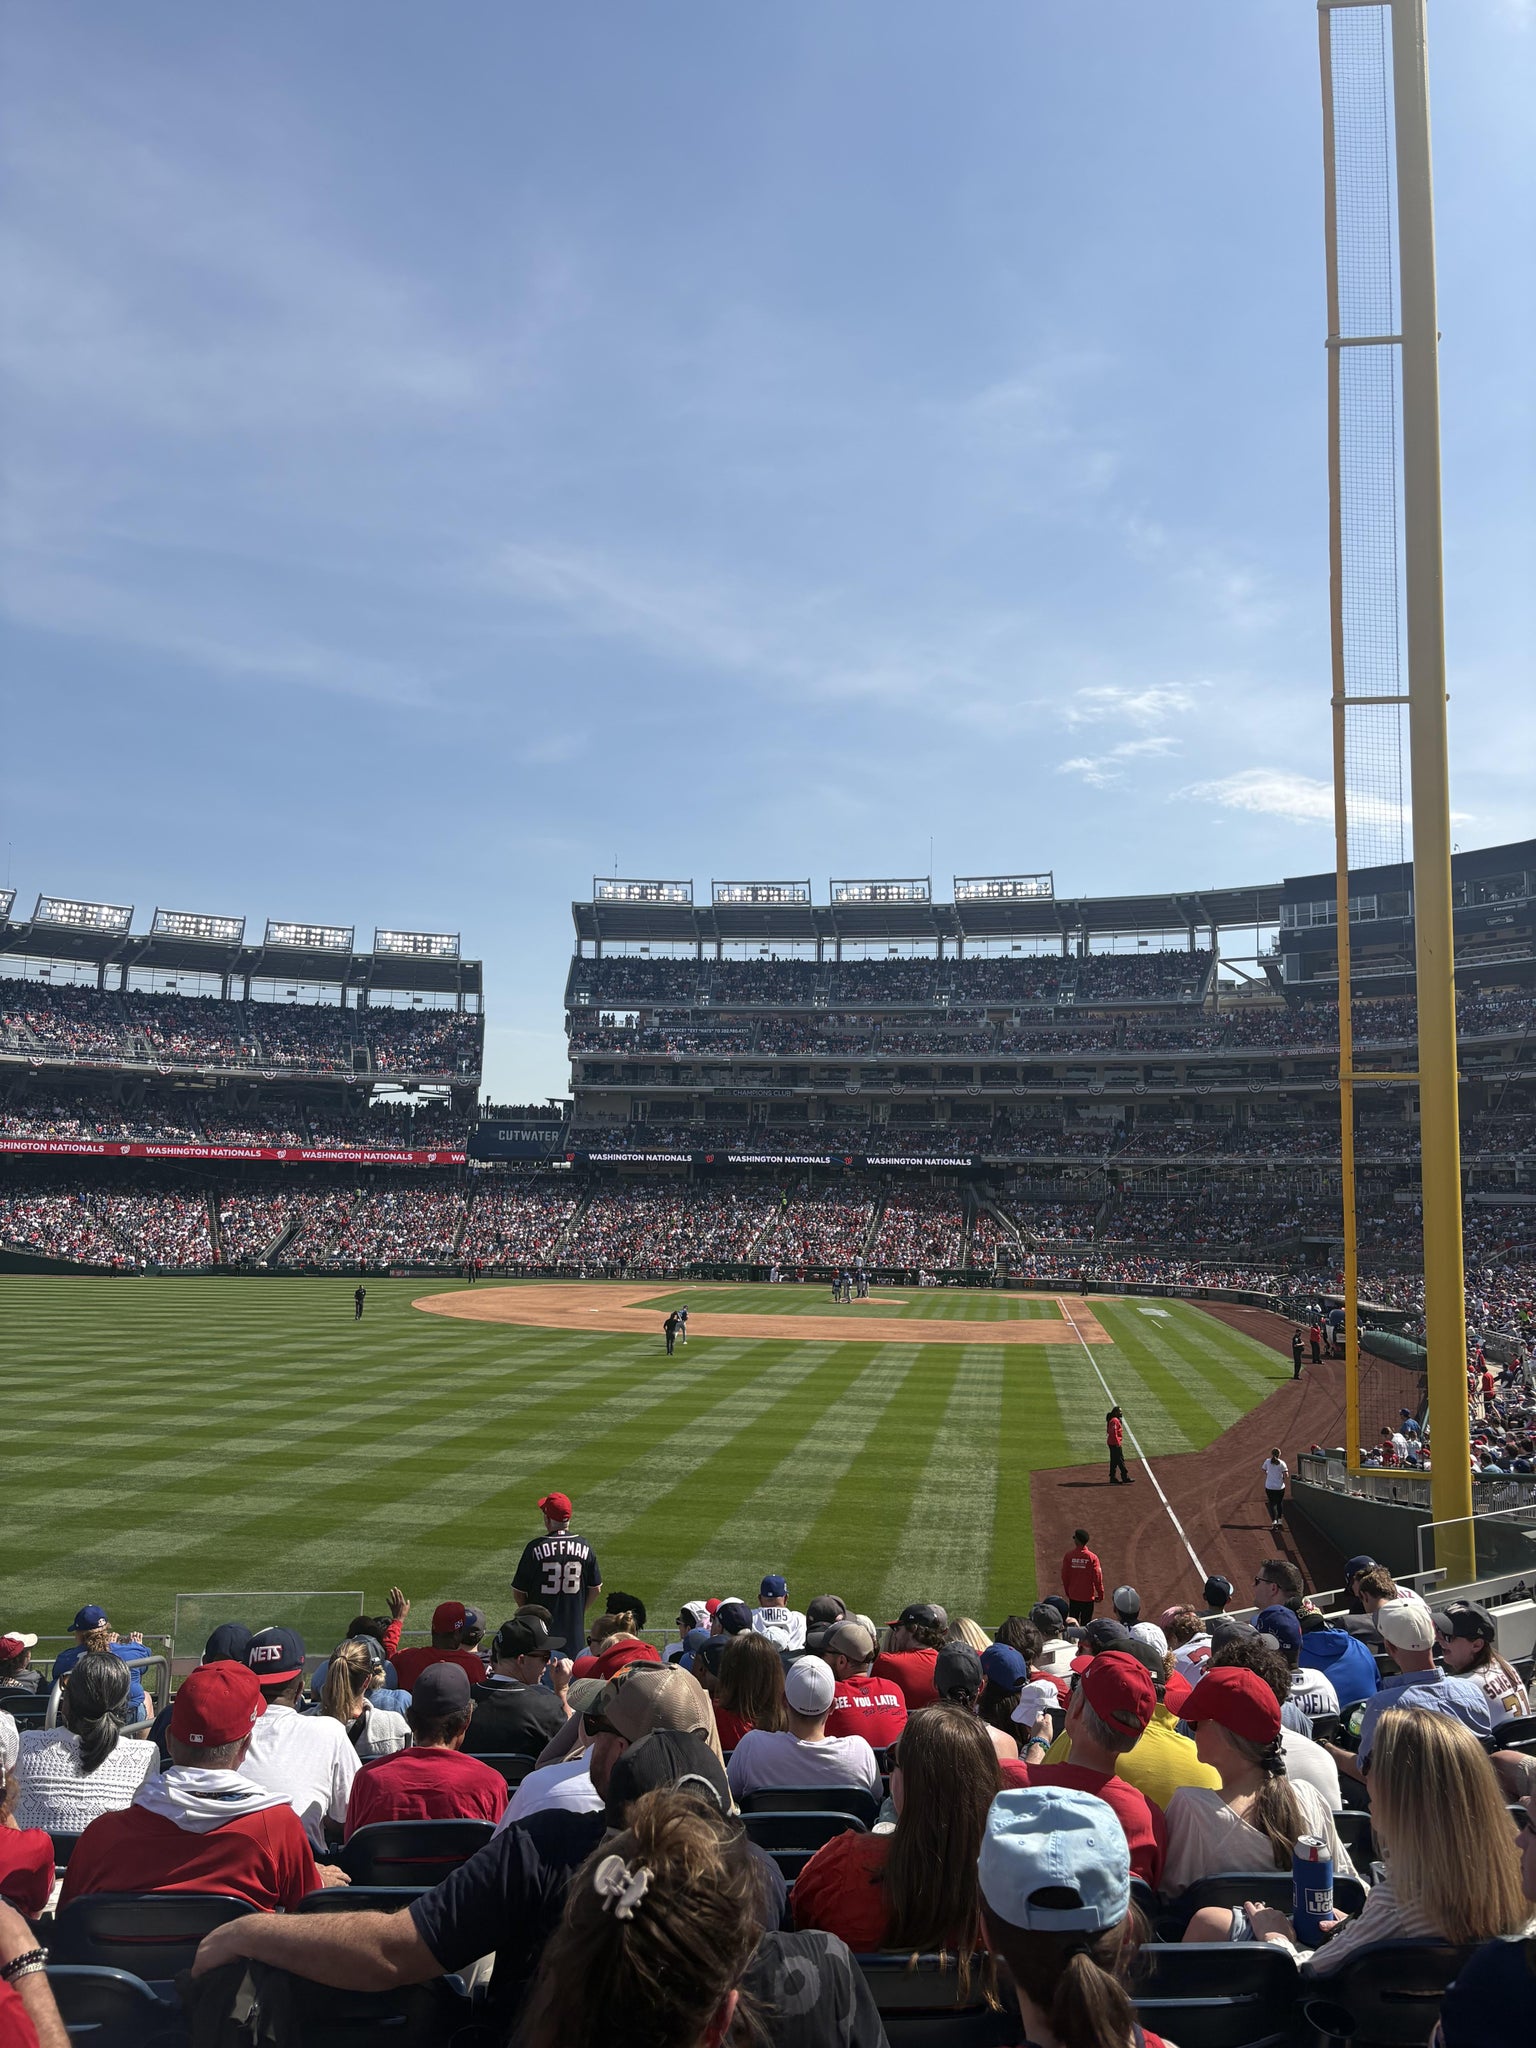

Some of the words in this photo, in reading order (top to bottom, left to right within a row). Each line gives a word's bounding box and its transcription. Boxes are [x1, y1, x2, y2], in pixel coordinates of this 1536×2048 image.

[733, 1089, 773, 1097] CHAMPIONS
[498, 1130, 559, 1142] CUTWATER
[49, 1143, 105, 1153] NATIONALS
[146, 1146, 209, 1156] WASHINGTON
[210, 1148, 262, 1158] NATIONALS
[302, 1151, 361, 1160] WASHINGTON
[363, 1152, 413, 1161] NATIONALS
[588, 1153, 643, 1162] WASHINGTON
[645, 1154, 693, 1162] NATIONALS
[728, 1155, 784, 1164] WASHINGTON
[784, 1156, 831, 1164] NATIONALS
[866, 1157, 923, 1166] WASHINGTON
[924, 1158, 972, 1166] NATIONALS
[533, 1540, 590, 1561] HOFFMAN
[541, 1561, 582, 1595] 38
[761, 1608, 788, 1622] URIAS
[249, 1645, 282, 1667] NETS
[834, 1695, 852, 1710] SEE.
[852, 1695, 875, 1708] YOU.
[1291, 1693, 1332, 1715] CHELL
